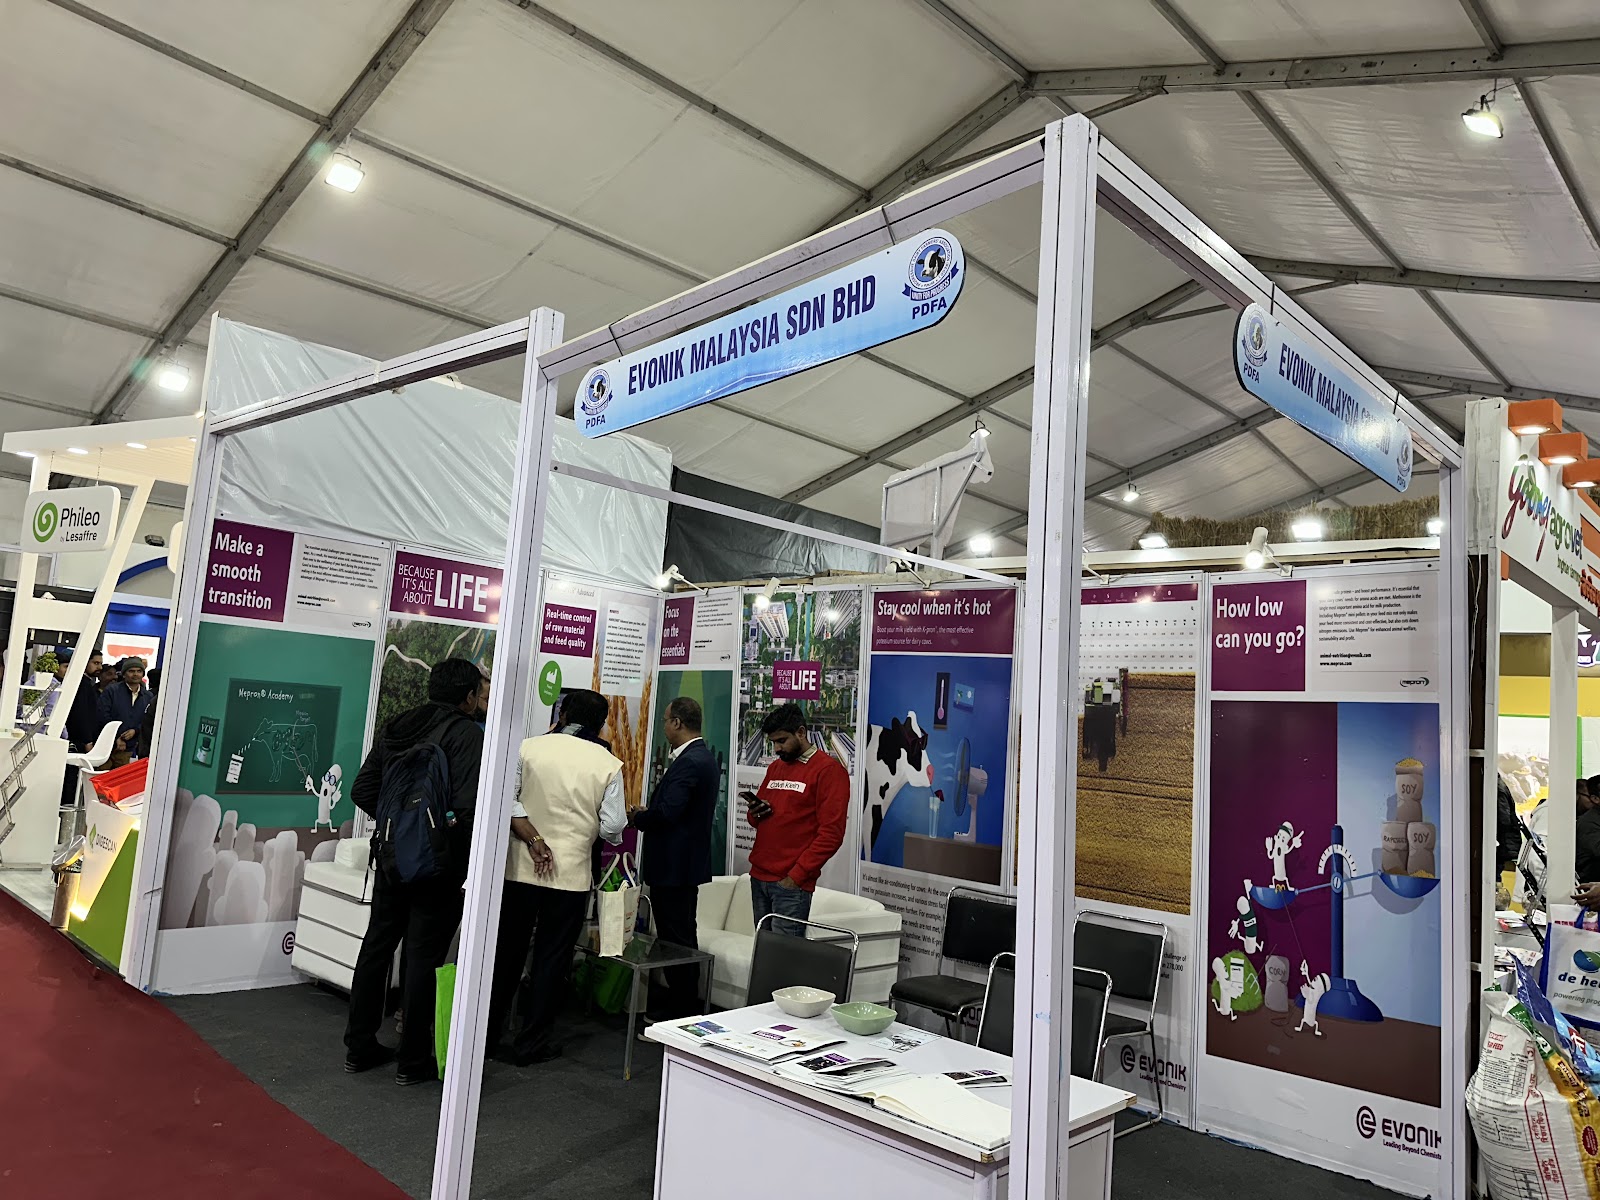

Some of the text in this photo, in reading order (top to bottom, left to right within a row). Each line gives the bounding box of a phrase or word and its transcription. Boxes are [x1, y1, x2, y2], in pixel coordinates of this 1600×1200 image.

[912, 296, 947, 320] PDFA
[628, 346, 686, 395] EVONIK
[689, 318, 780, 374] MALAYSIA
[786, 296, 824, 340] SDN
[833, 274, 876, 322] BHD
[1243, 362, 1260, 384] PDFA
[1278, 343, 1316, 400] EVONIK
[1316, 372, 1359, 428] MALAYSIA
[586, 414, 605, 429] PDFA
[60, 507, 100, 527] Phileo
[66, 530, 97, 542] Lesaffre
[1550, 507, 1583, 560] agrovet
[215, 532, 263, 556] Make a
[212, 563, 261, 582] smooth
[398, 564, 434, 579] BECAUSE
[402, 577, 432, 592] IT'S ALL
[434, 570, 489, 612] LIFE
[208, 587, 271, 609] transition
[403, 591, 432, 605] ABOUT
[665, 606, 679, 618] Focus
[878, 598, 991, 620] Stay cool when it's hot
[1217, 596, 1283, 618] How low
[546, 608, 592, 623] Real-time control
[544, 621, 585, 635] of raw material
[664, 628, 670, 637] on
[904, 626, 913, 634] yield
[544, 635, 586, 650] and feed quality
[912, 637, 920, 646] dairy
[1216, 625, 1304, 654] can you go?
[662, 642, 685, 657] essentials
[792, 670, 816, 690] LIFE
[267, 689, 294, 703] Academy
[200, 723, 216, 736] YOU
[1402, 784, 1417, 794] SOY
[1414, 832, 1429, 843] SOY
[1269, 967, 1286, 976] CORN
[1558, 972, 1576, 984] de
[1553, 992, 1584, 1003] powering
[1140, 1073, 1186, 1092] Leading Chemistry
[1383, 1139, 1419, 1154] Leading Beyond
